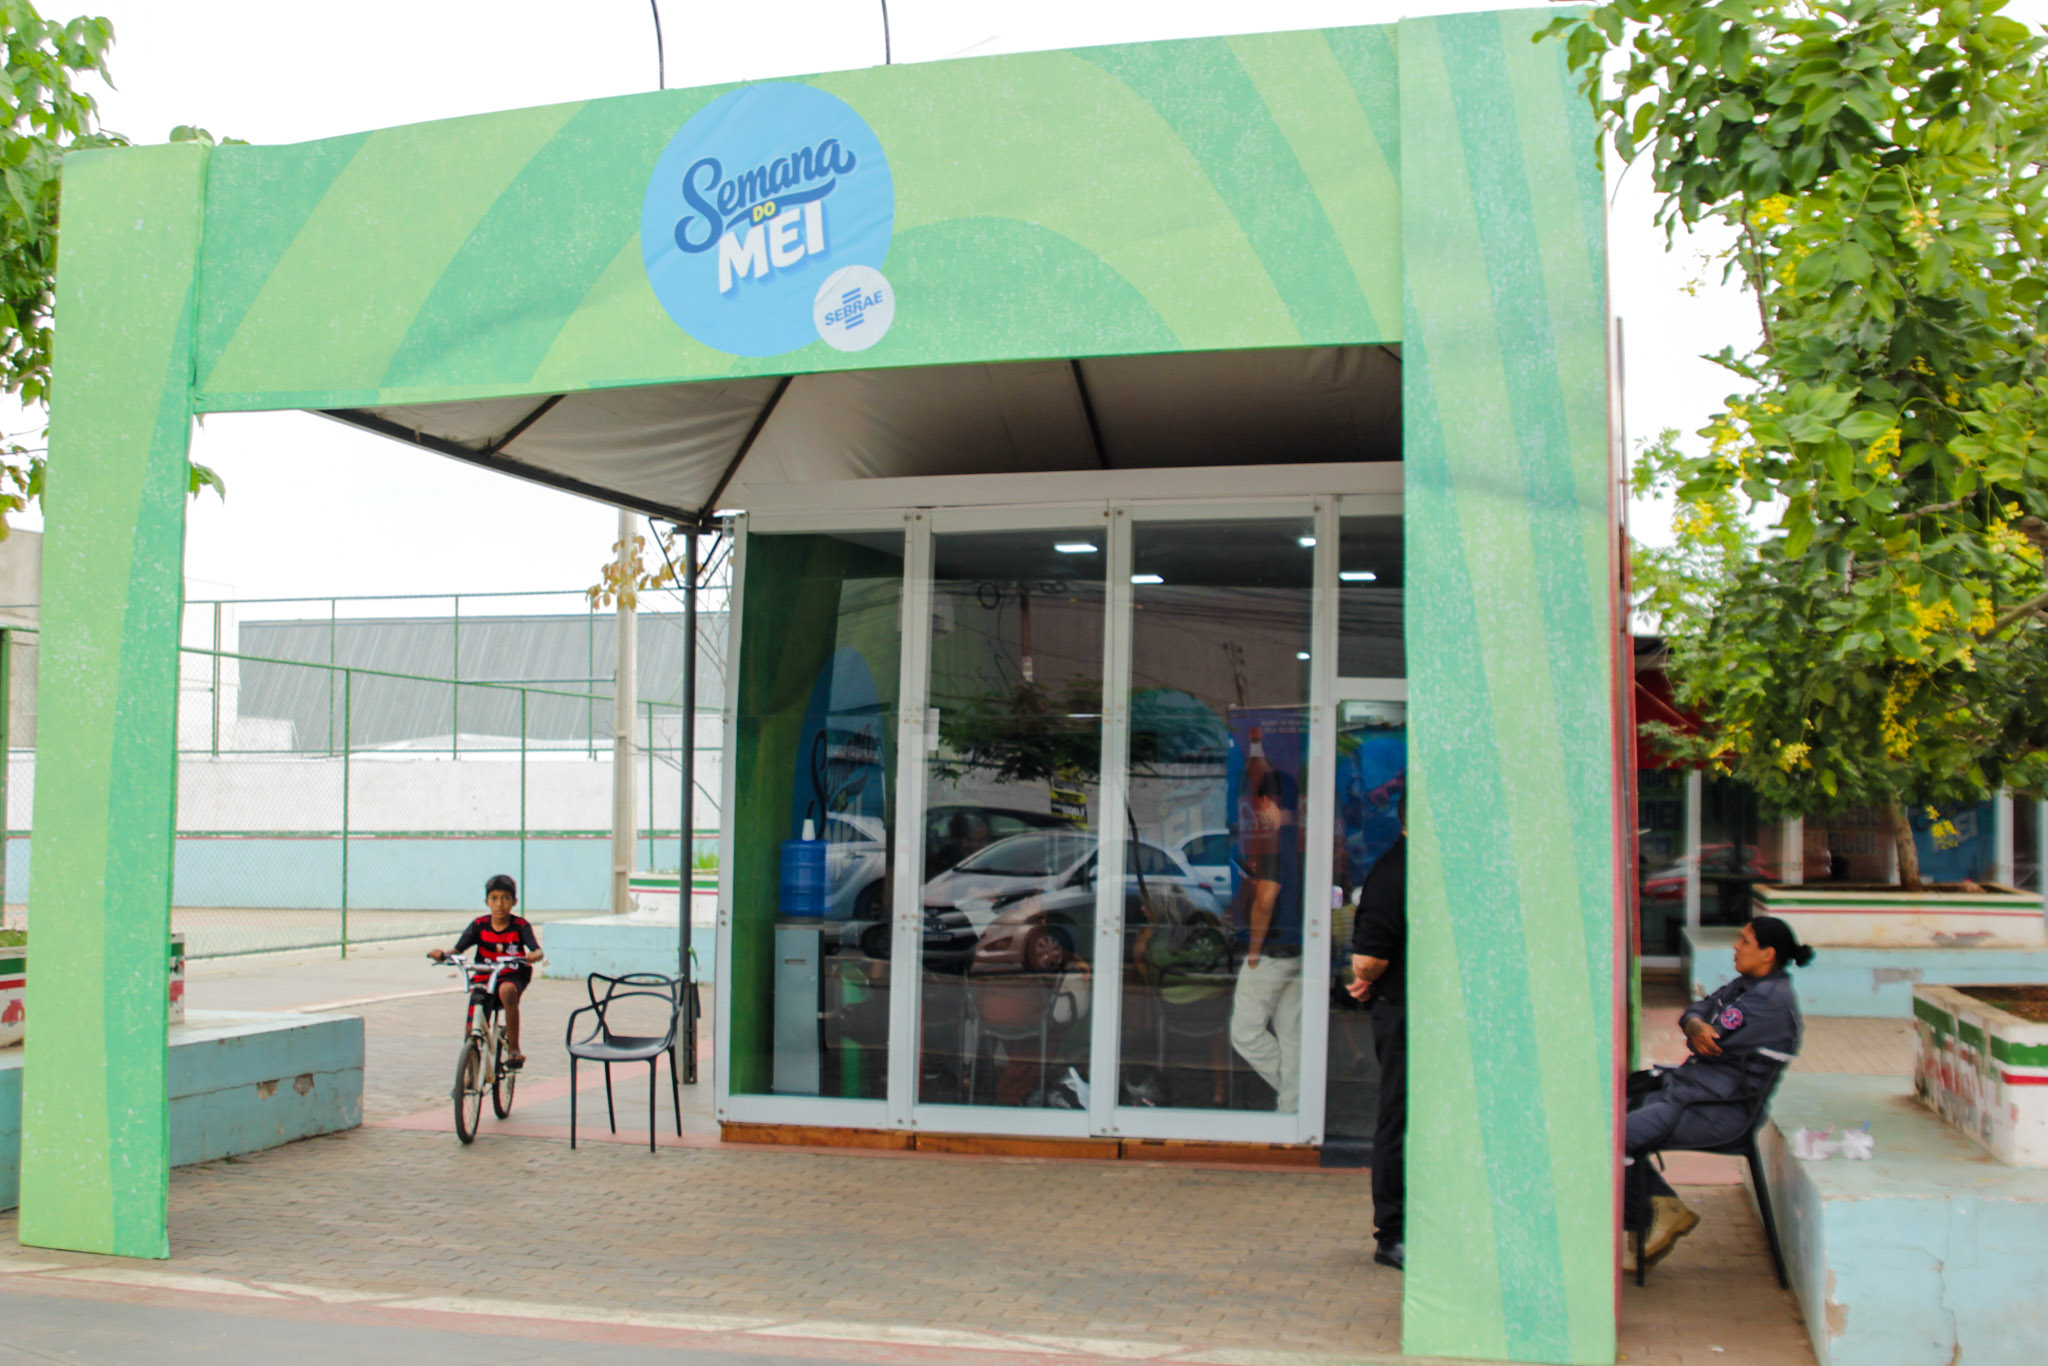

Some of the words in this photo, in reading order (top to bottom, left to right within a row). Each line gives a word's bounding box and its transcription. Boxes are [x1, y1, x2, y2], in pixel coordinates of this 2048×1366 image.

[674, 138, 856, 253] Semana
[753, 201, 776, 223] DO
[718, 200, 826, 294] MEI
[825, 290, 883, 326] SEBRAE
